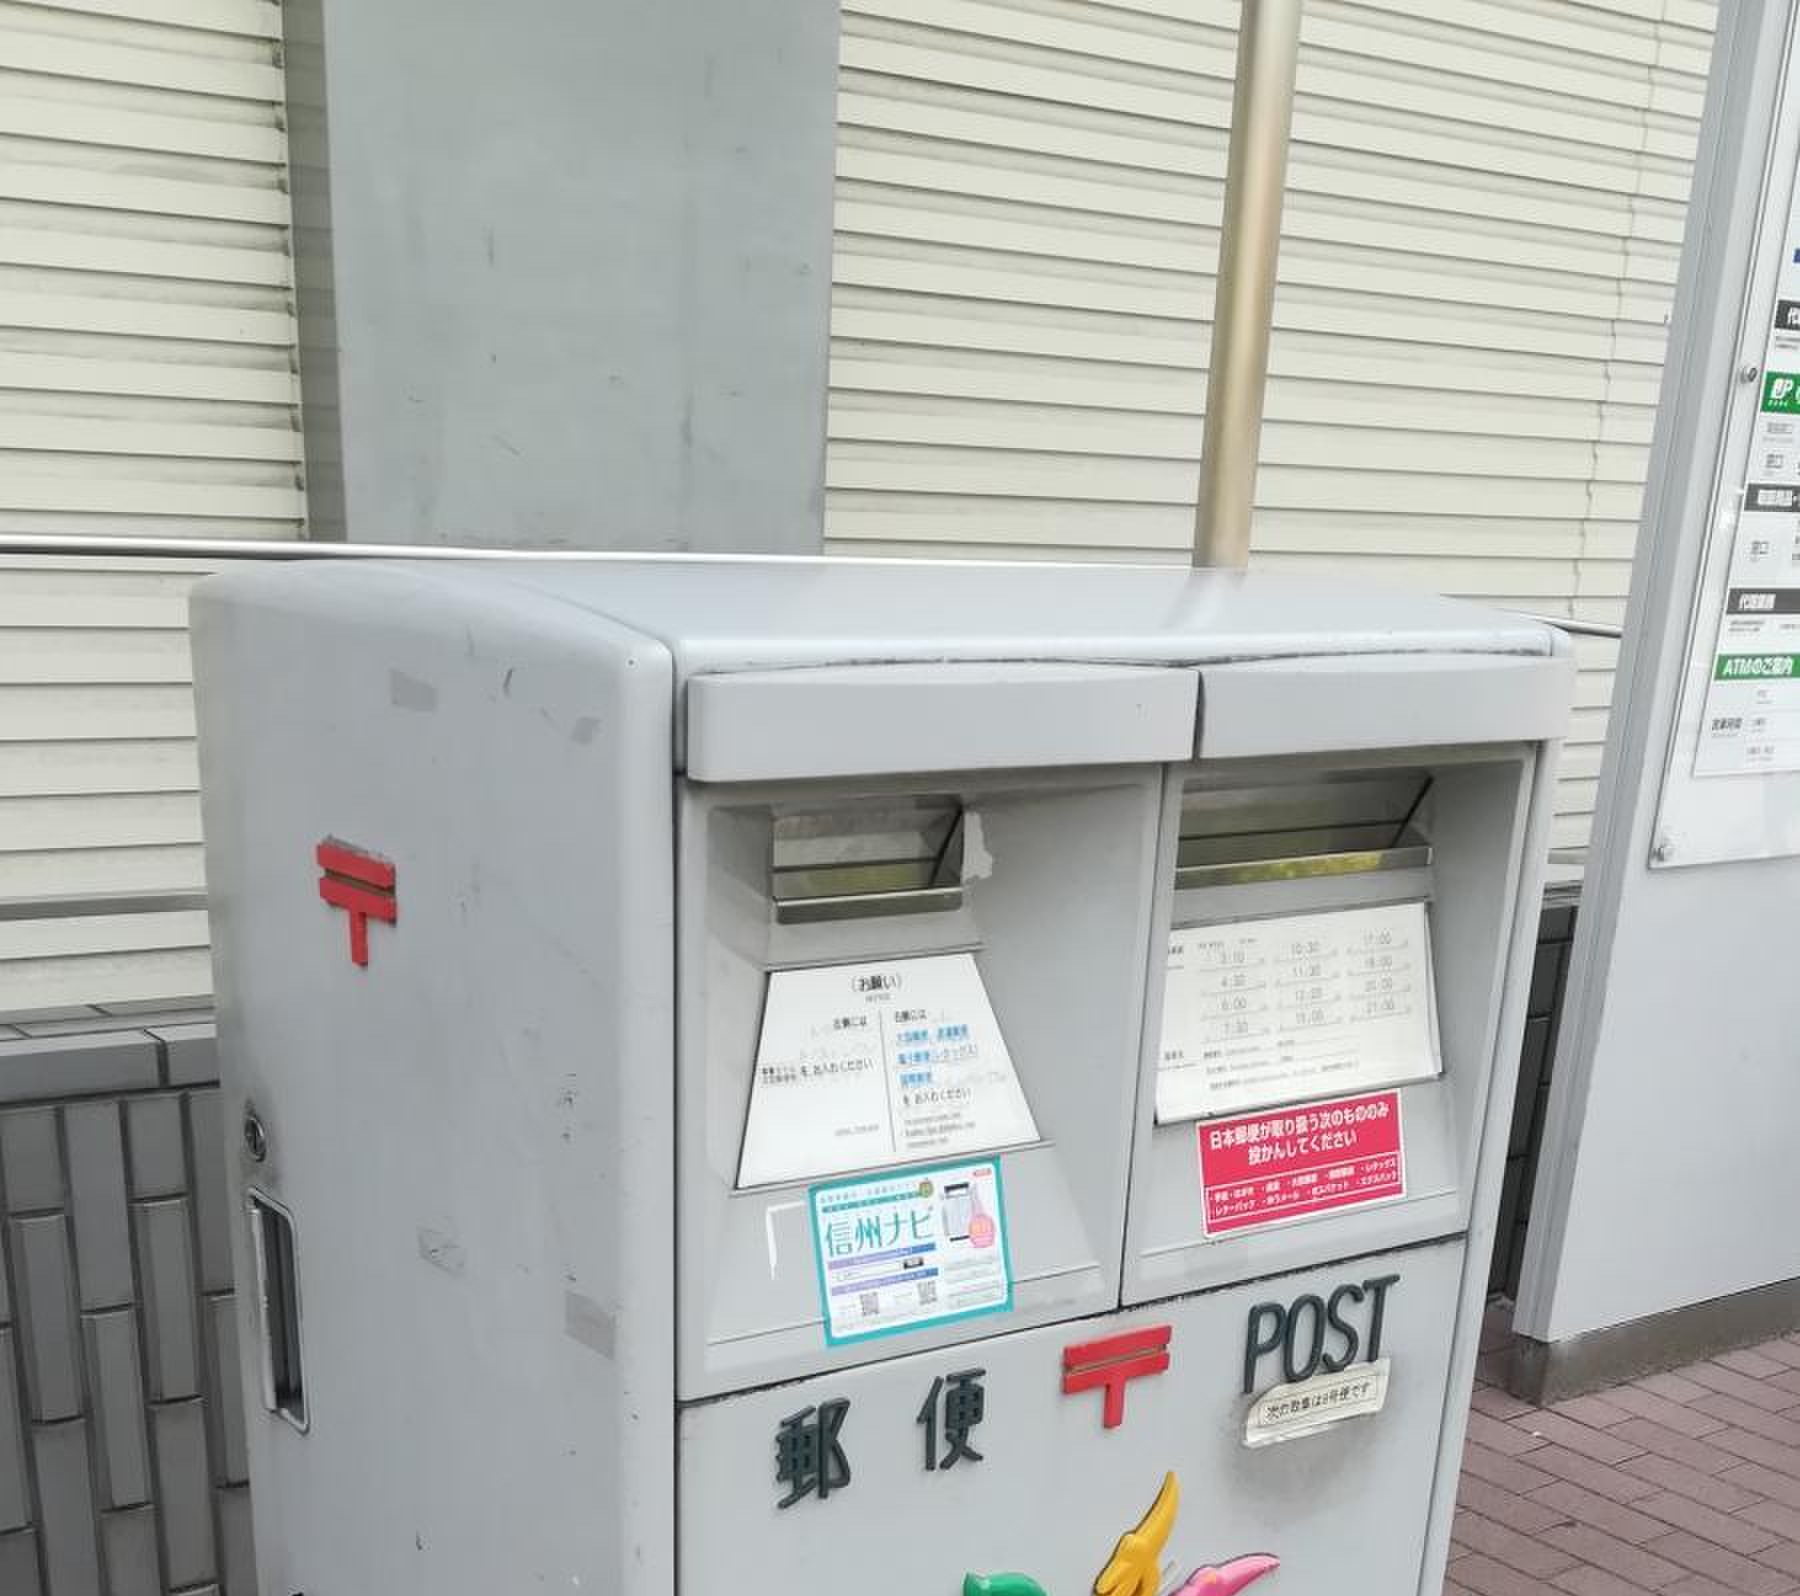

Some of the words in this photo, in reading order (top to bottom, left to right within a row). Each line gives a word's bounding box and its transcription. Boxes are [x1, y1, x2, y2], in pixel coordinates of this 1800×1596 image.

[1209, 1101, 1390, 1150] 日本郵便が取り扱う次のもののみ
[1248, 1130, 1358, 1166] 投かんしてください
[825, 1205, 934, 1258] 信州ナビ
[1242, 1273, 1401, 1394] POST
